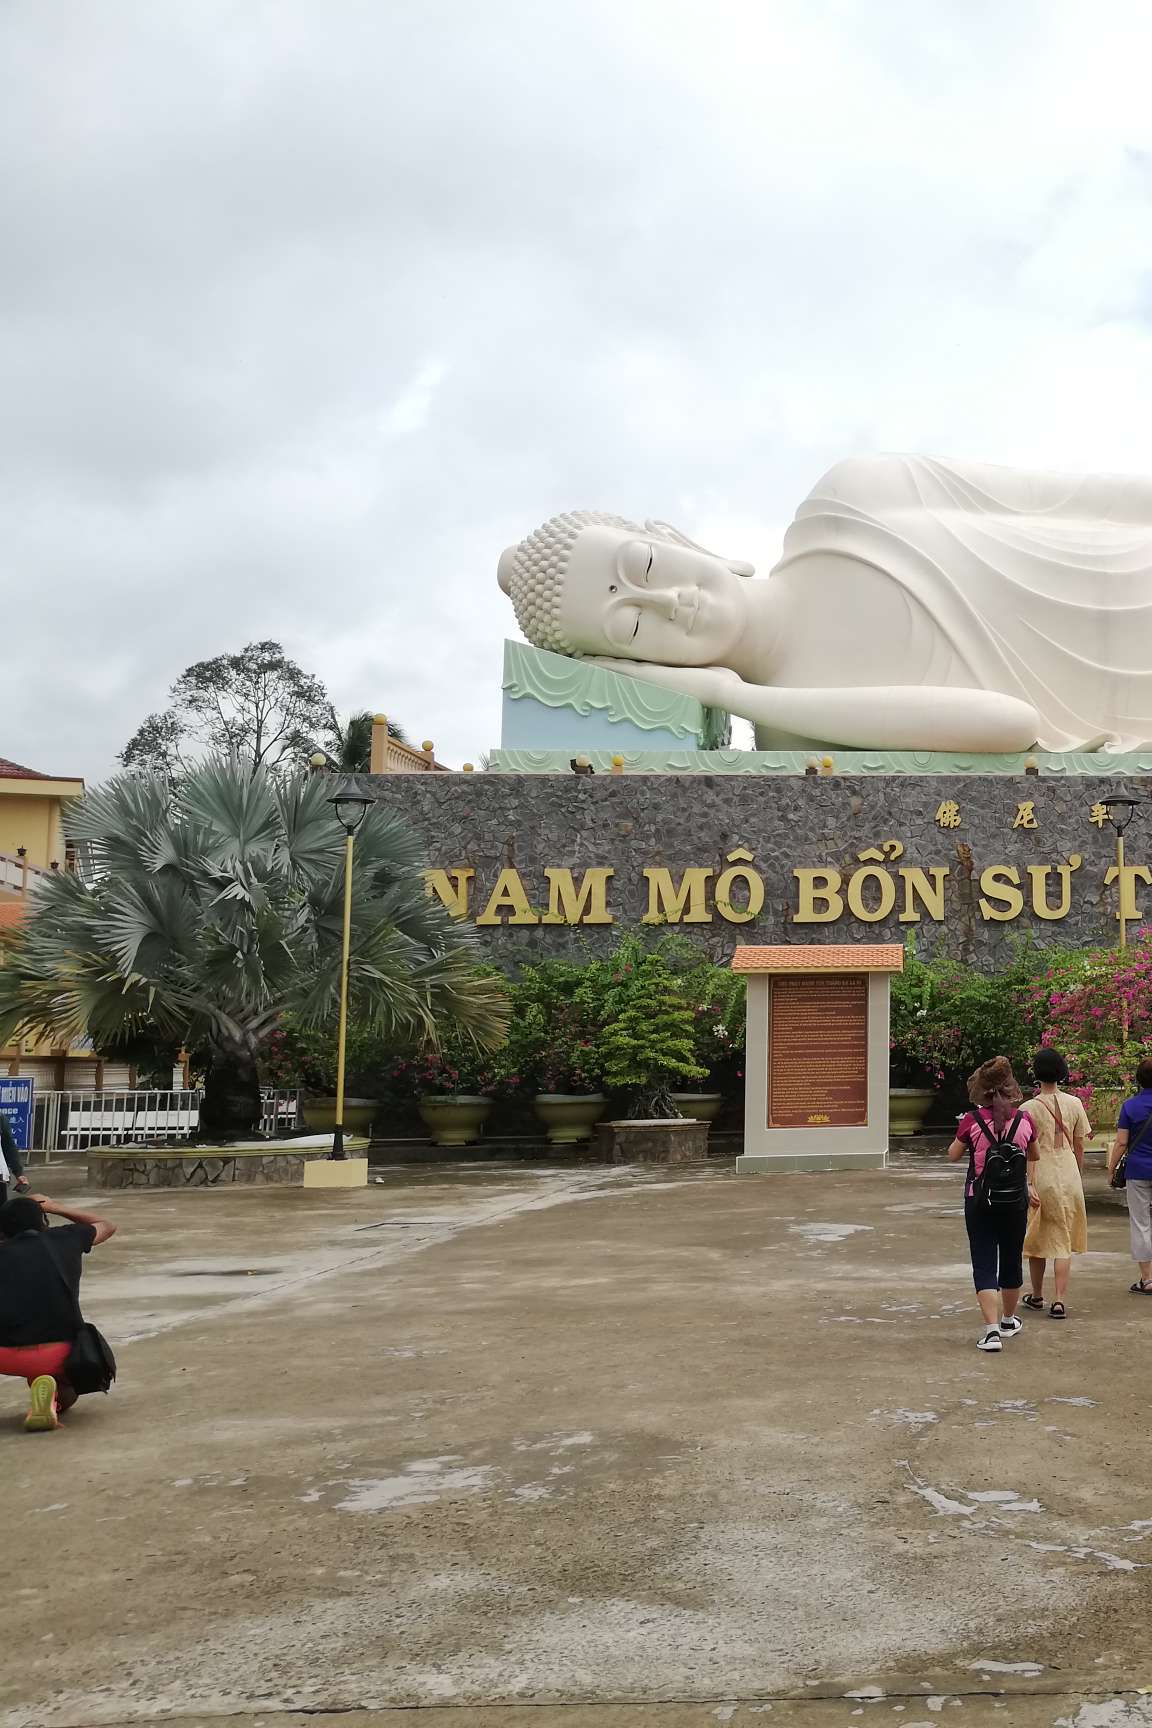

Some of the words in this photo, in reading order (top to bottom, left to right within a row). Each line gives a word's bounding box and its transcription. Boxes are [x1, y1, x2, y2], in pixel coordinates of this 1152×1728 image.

[424, 868, 613, 925] NAM
[642, 848, 765, 924] MÔ
[793, 841, 949, 922] BỔN
[979, 854, 1081, 920] SƯ
